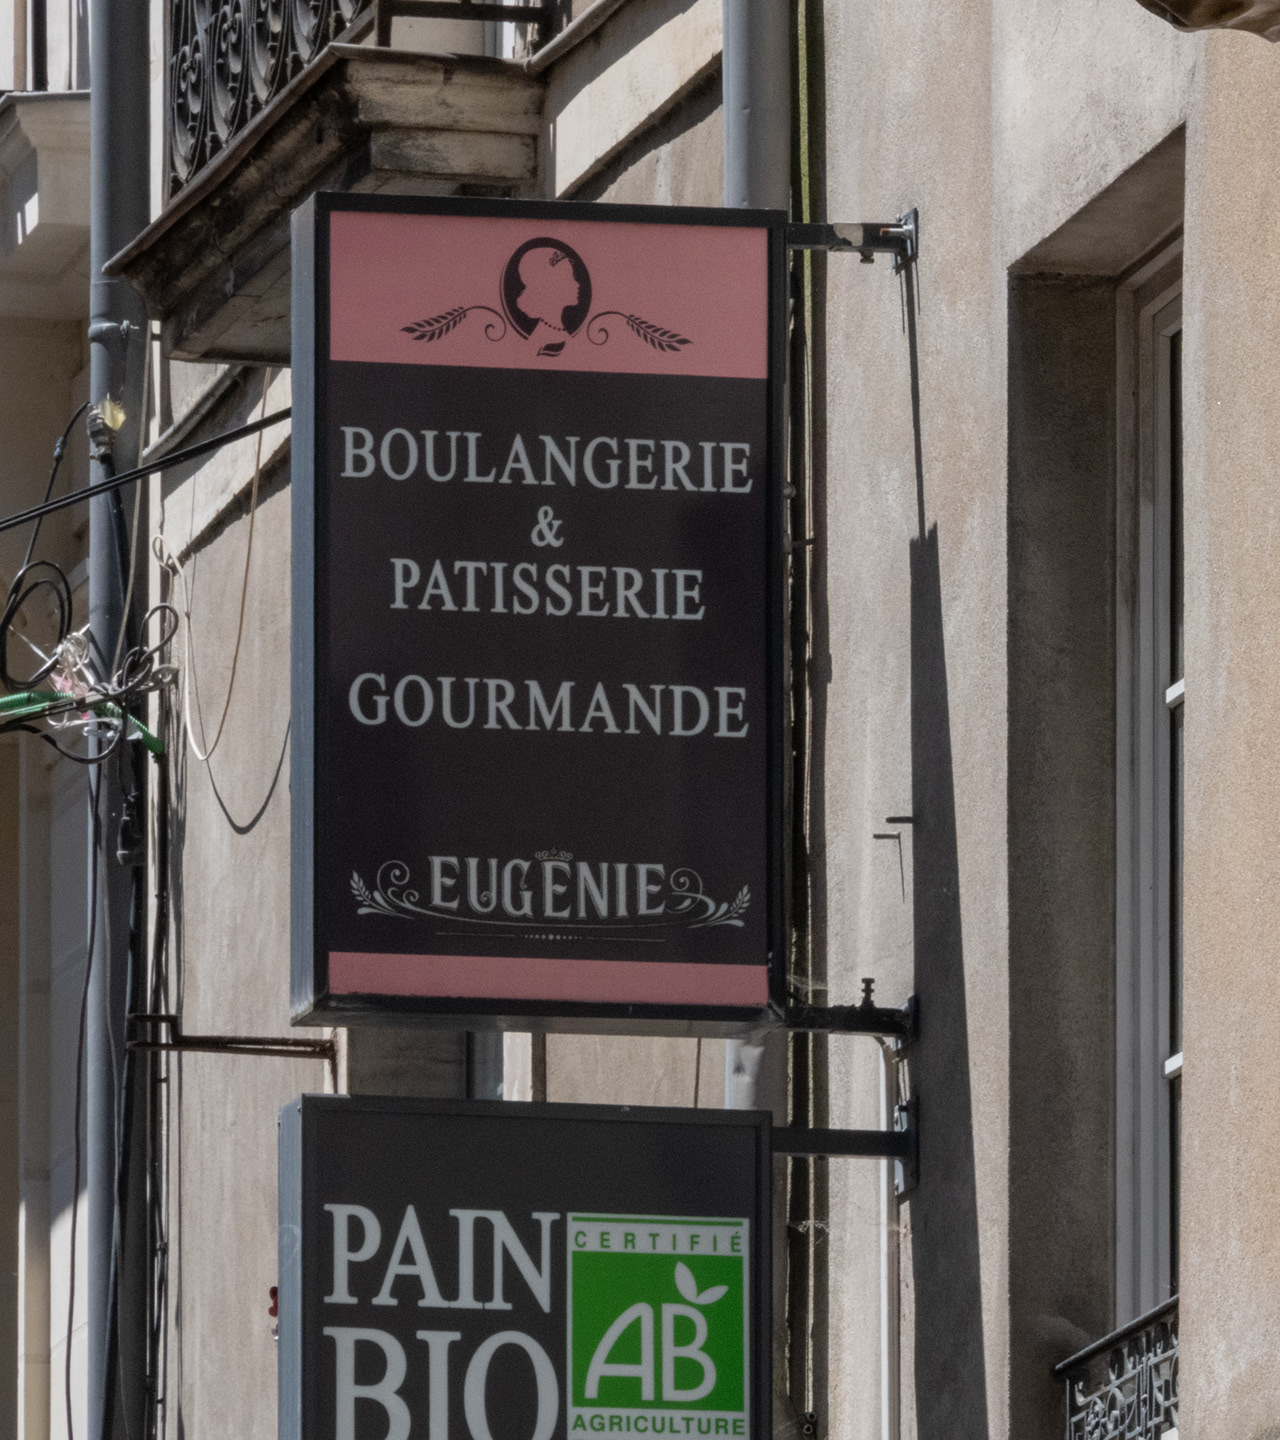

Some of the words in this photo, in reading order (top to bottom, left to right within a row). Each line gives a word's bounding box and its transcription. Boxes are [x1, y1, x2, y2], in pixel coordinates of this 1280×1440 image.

[340, 425, 754, 494] BOULANGERIE
[530, 505, 564, 548] &
[389, 558, 707, 621] PATISSERIE
[348, 673, 750, 738] GOURMANDE
[323, 1203, 560, 1313] PAIN
[574, 1230, 743, 1253] CERTIFIÉ
[323, 1326, 560, 1440] BIO
[584, 1302, 718, 1402] AB
[572, 1413, 747, 1436] AGRICULTURE
